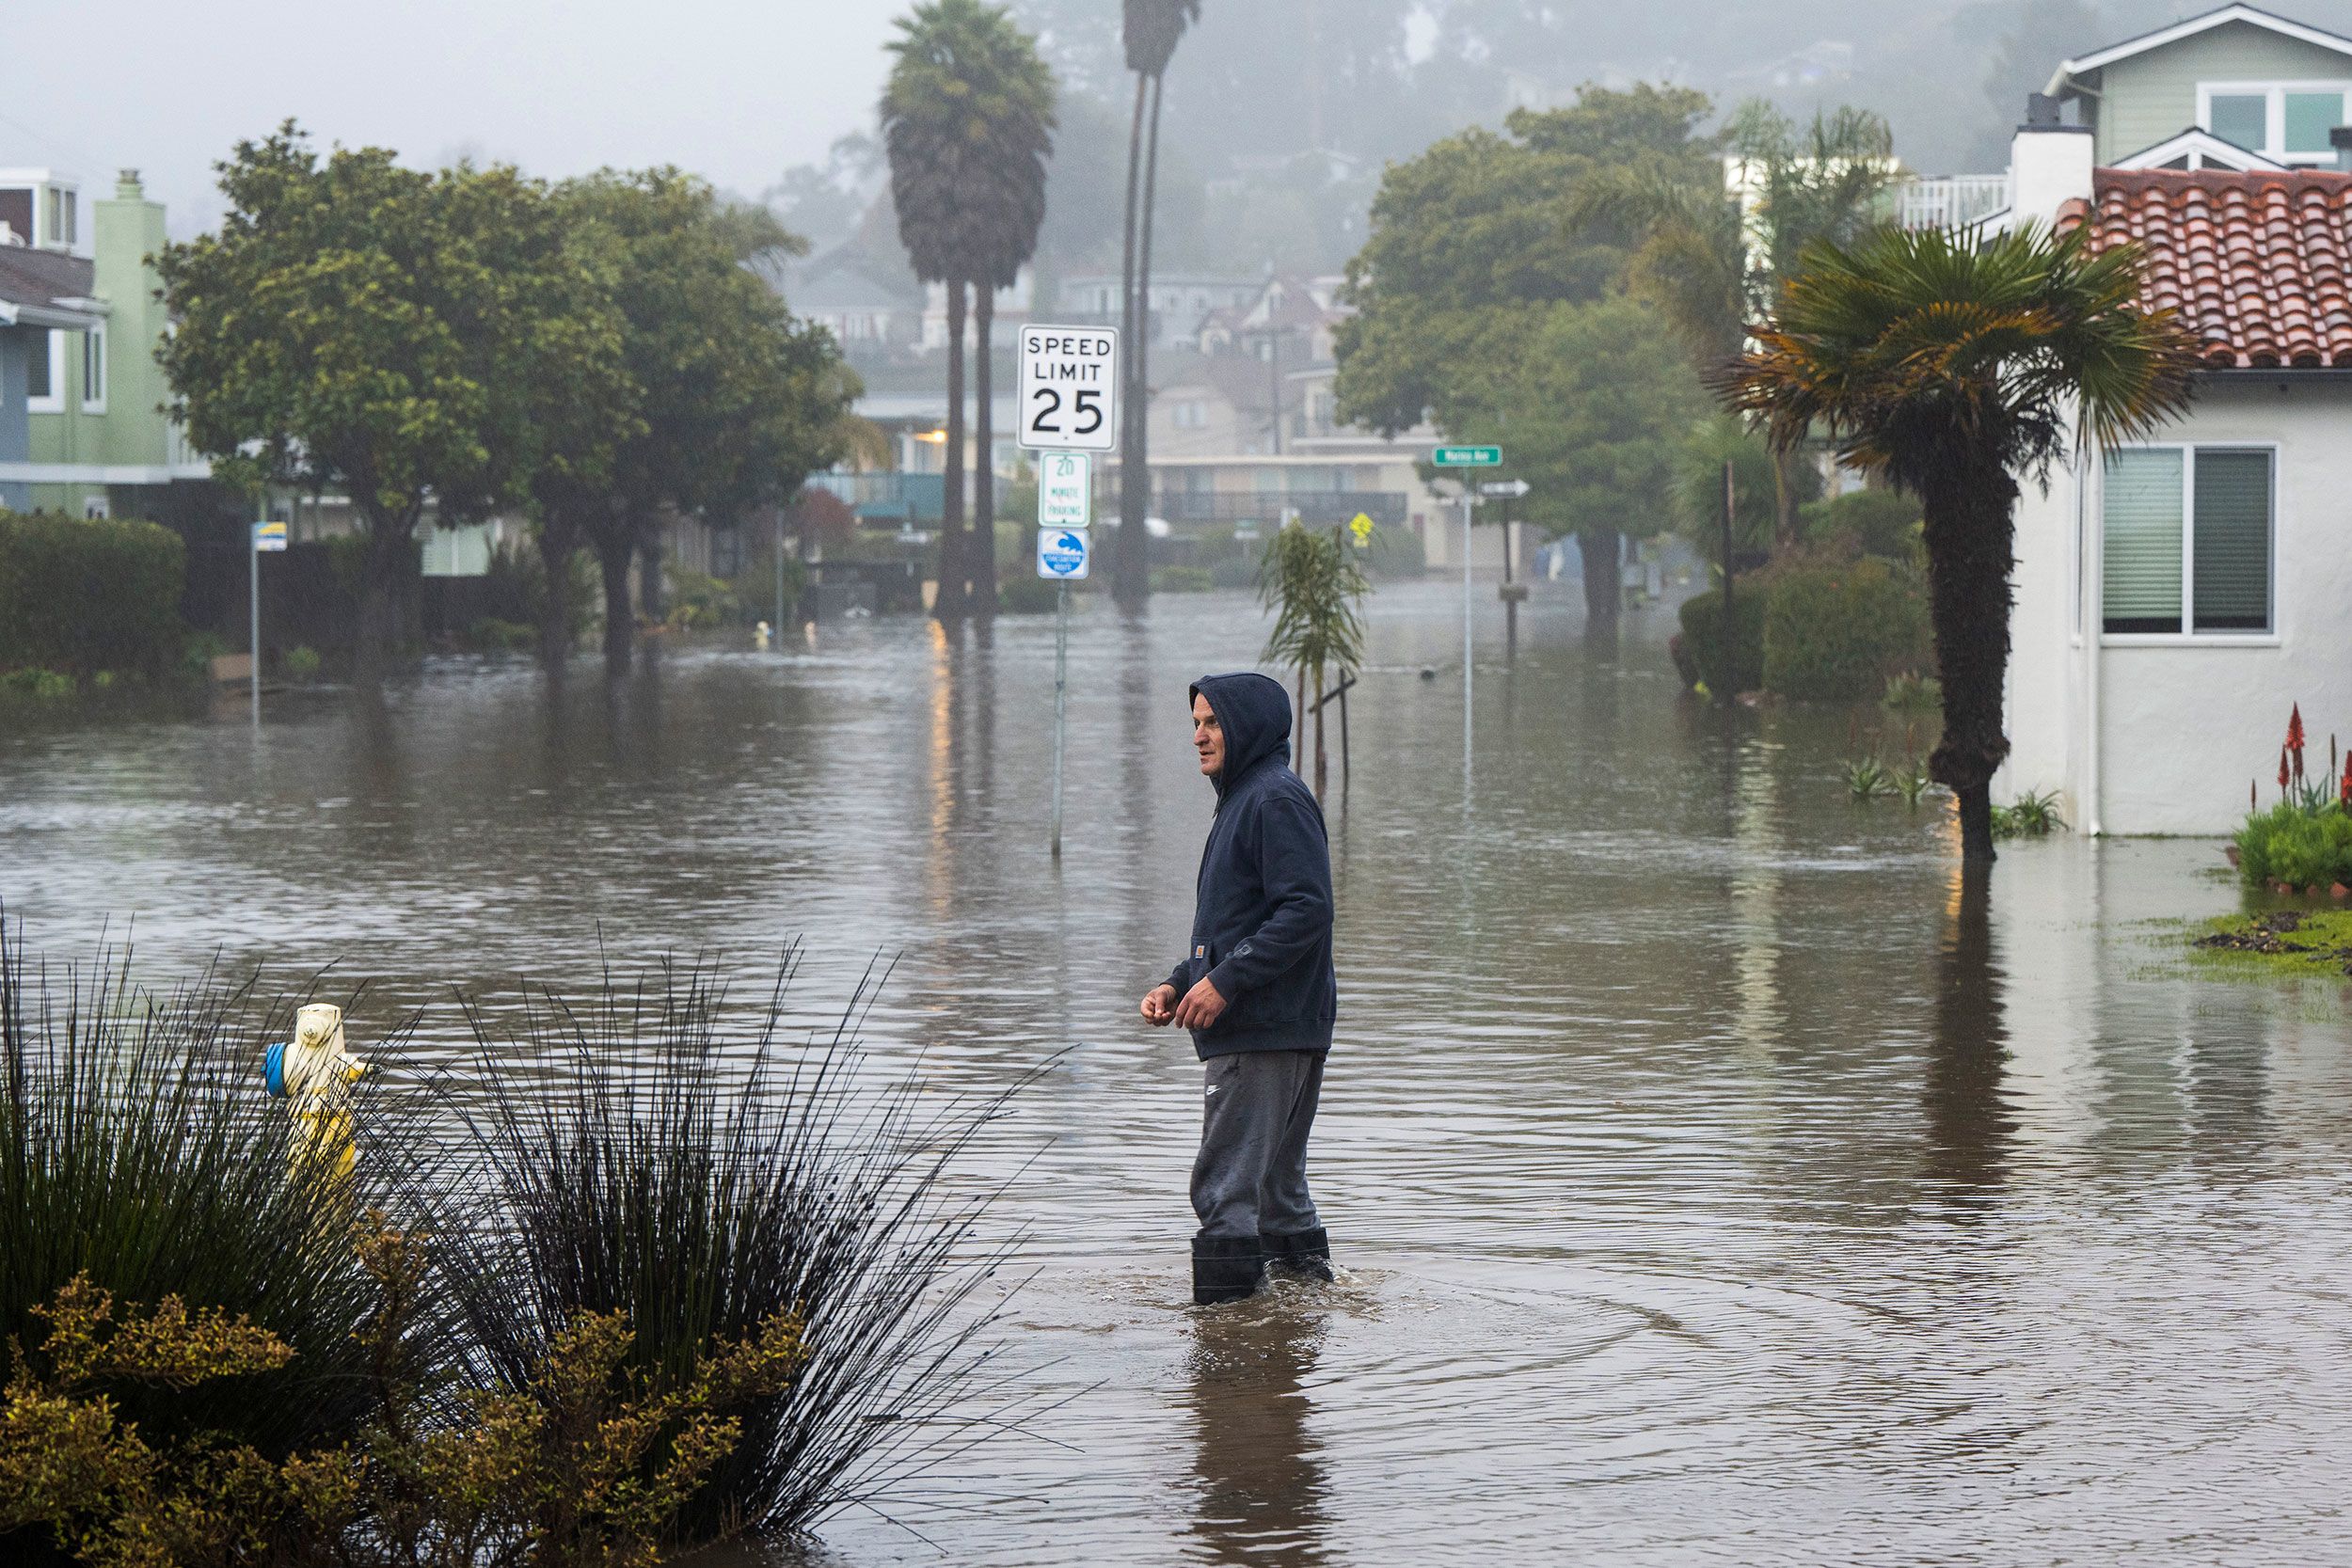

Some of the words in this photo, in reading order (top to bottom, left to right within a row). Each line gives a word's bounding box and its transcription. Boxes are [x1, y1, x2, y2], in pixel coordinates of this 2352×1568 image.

[1027, 337, 1111, 356] SPEED
[1035, 362, 1102, 382] LIMIT
[1032, 388, 1103, 434] 25
[1057, 458, 1074, 477] 20
